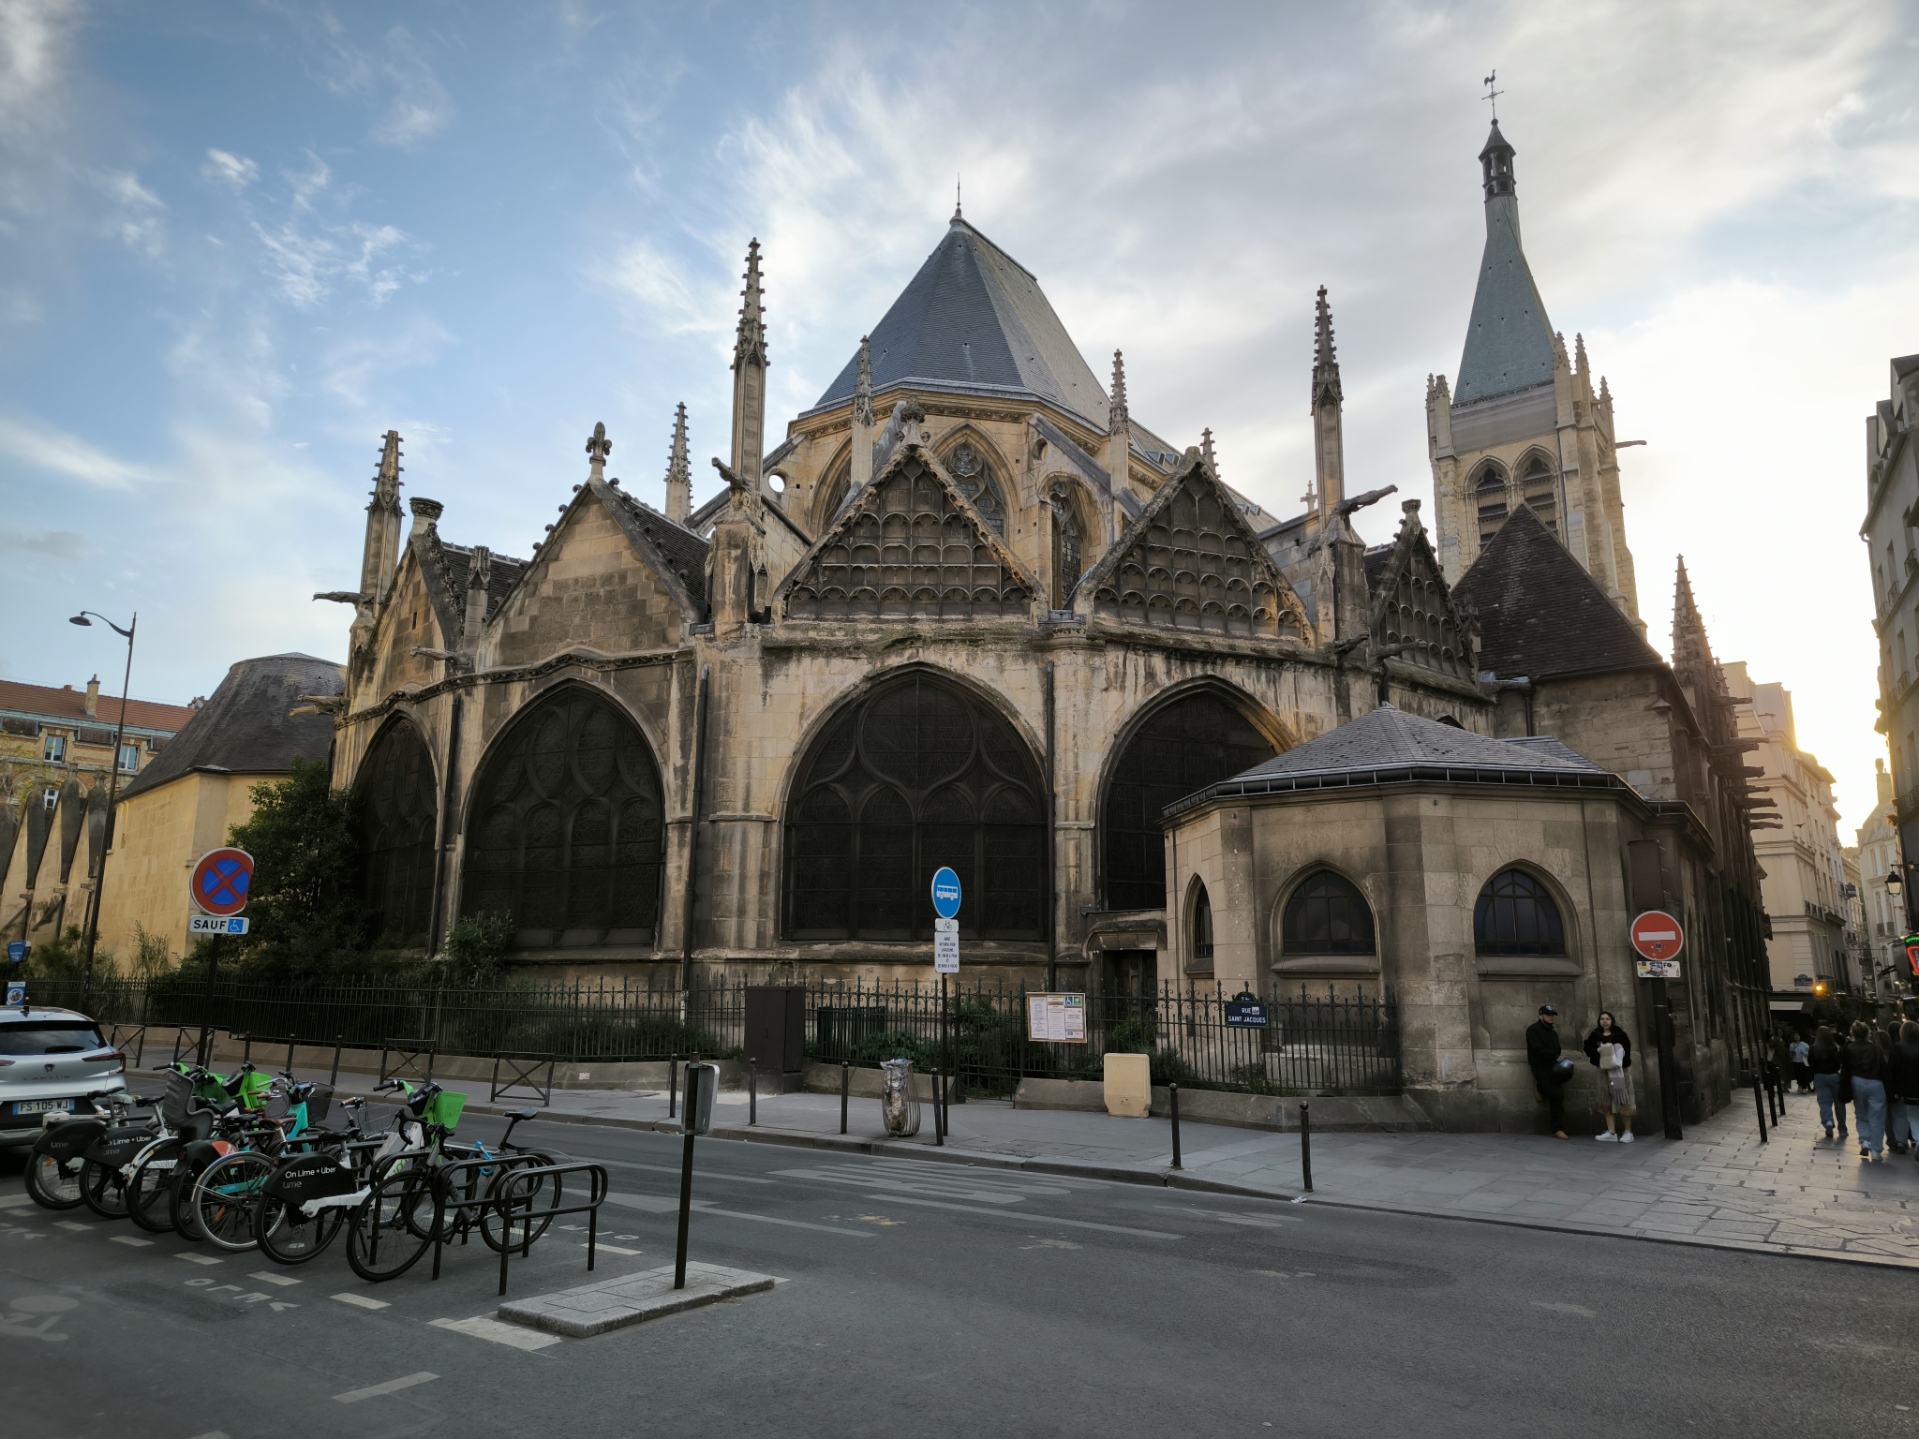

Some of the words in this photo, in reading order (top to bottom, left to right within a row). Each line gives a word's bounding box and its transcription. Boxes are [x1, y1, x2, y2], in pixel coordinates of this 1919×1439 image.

[193, 919, 227, 930] SAUF
[1243, 1016, 1266, 1024] JACQUES
[50, 1141, 69, 1149] Lime
[113, 1138, 130, 1146] Lime
[136, 1135, 152, 1143] Uber
[285, 1171, 297, 1179] On
[297, 1169, 315, 1178] Lime
[320, 1166, 337, 1174] Uber
[282, 1181, 302, 1189] Lime
[765, 1161, 1112, 1204] BUS
